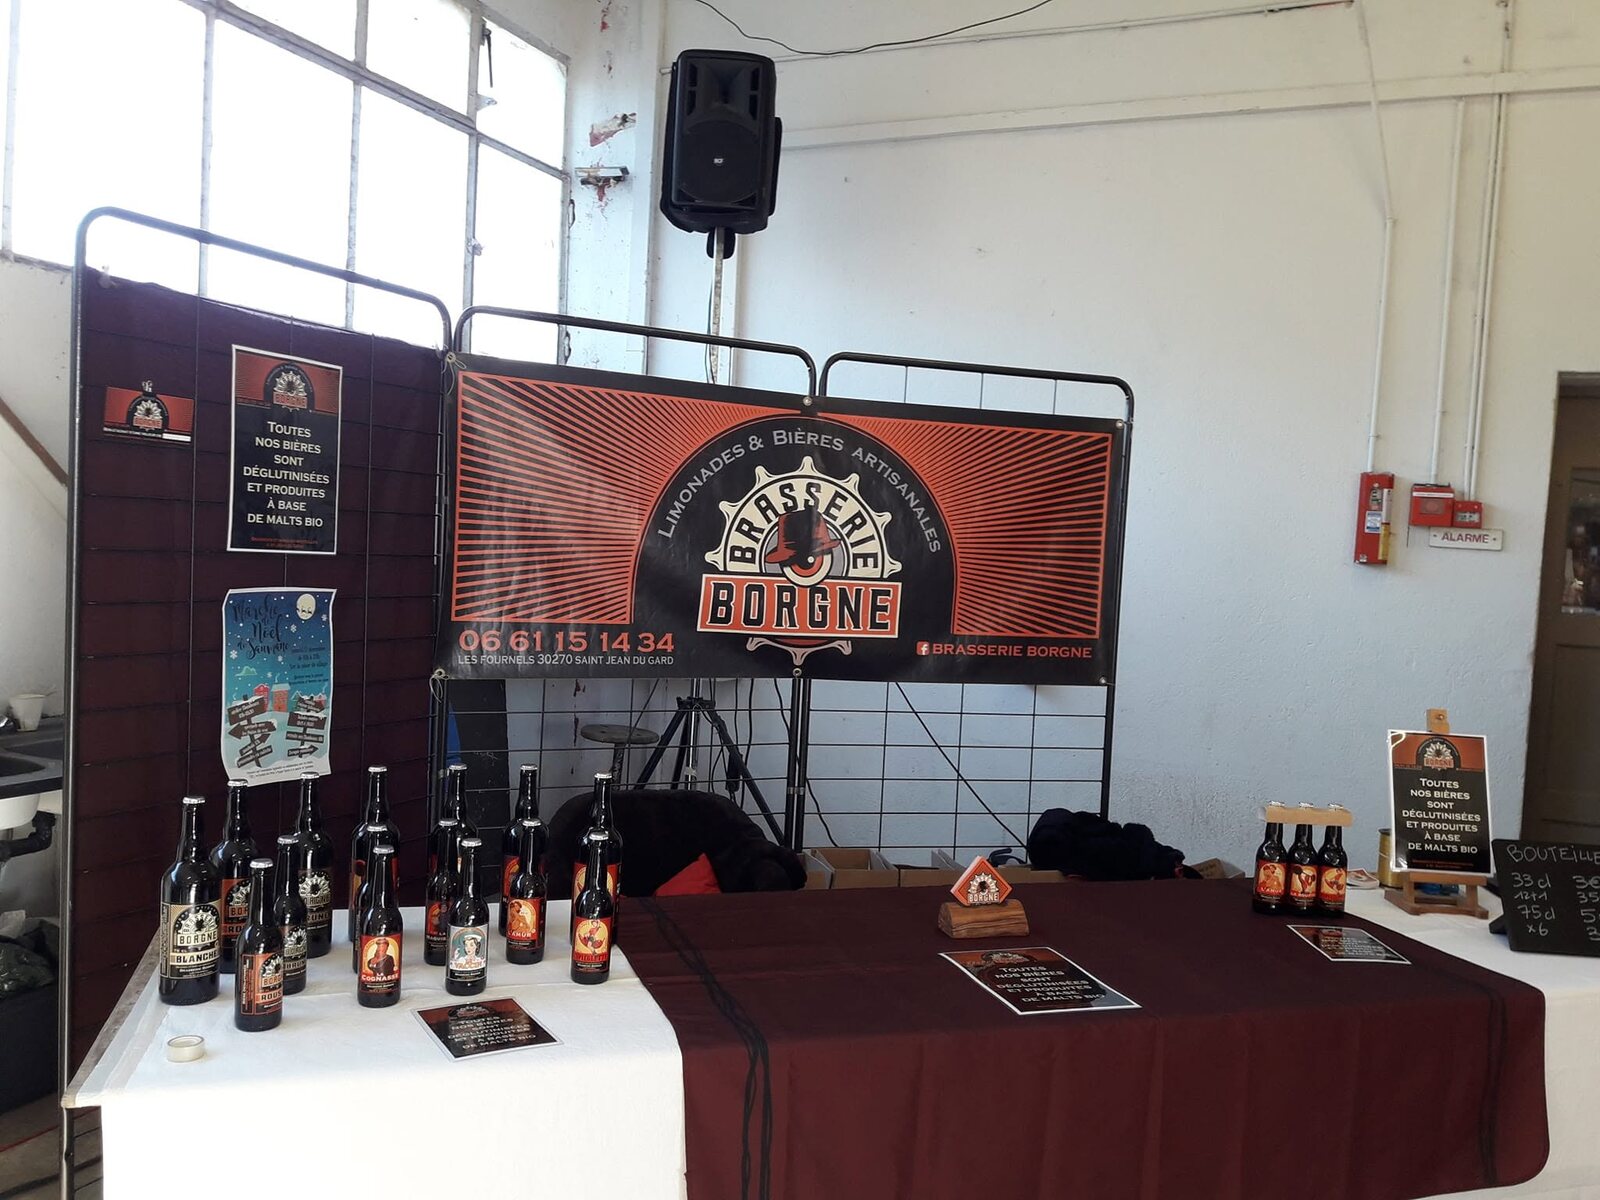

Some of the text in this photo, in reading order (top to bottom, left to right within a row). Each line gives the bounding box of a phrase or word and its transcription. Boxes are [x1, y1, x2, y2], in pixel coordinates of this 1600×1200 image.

[267, 421, 311, 437] TOUTES
[255, 437, 321, 454] NOS BIÈRES
[273, 454, 304, 466] SONT
[243, 464, 330, 484] DÉGLUTINISÉES
[247, 482, 326, 499] ET PRODUITES
[657, 427, 941, 553] LIMONADES & BIÈRES ARTISANALES
[267, 496, 307, 511] À BASE
[247, 513, 323, 527] DE MALTS BIO
[729, 481, 880, 570] BRASSERIE
[1441, 532, 1490, 543] ALARME
[706, 581, 892, 632] BORGNE
[458, 629, 675, 653] 06 61 15 14 34
[932, 643, 1092, 659] BRASSERIE BORGNE
[458, 653, 674, 665] LES FOURNELS 30270 SAINT JEAN DU GARD
[1420, 778, 1459, 788] TOUTES
[1410, 789, 1470, 800] NOS BIÈRES
[1427, 800, 1454, 809] SONT
[1402, 808, 1481, 822] DÉGLUTINISÉES
[1406, 820, 1478, 832] ET PRODUITES
[1424, 830, 1461, 842] À BASE
[1408, 842, 1478, 854] DE MALTS BIO
[179, 930, 217, 945] BORGNE
[176, 950, 217, 964] BLANCHE
[361, 972, 399, 982] COGNASSE
